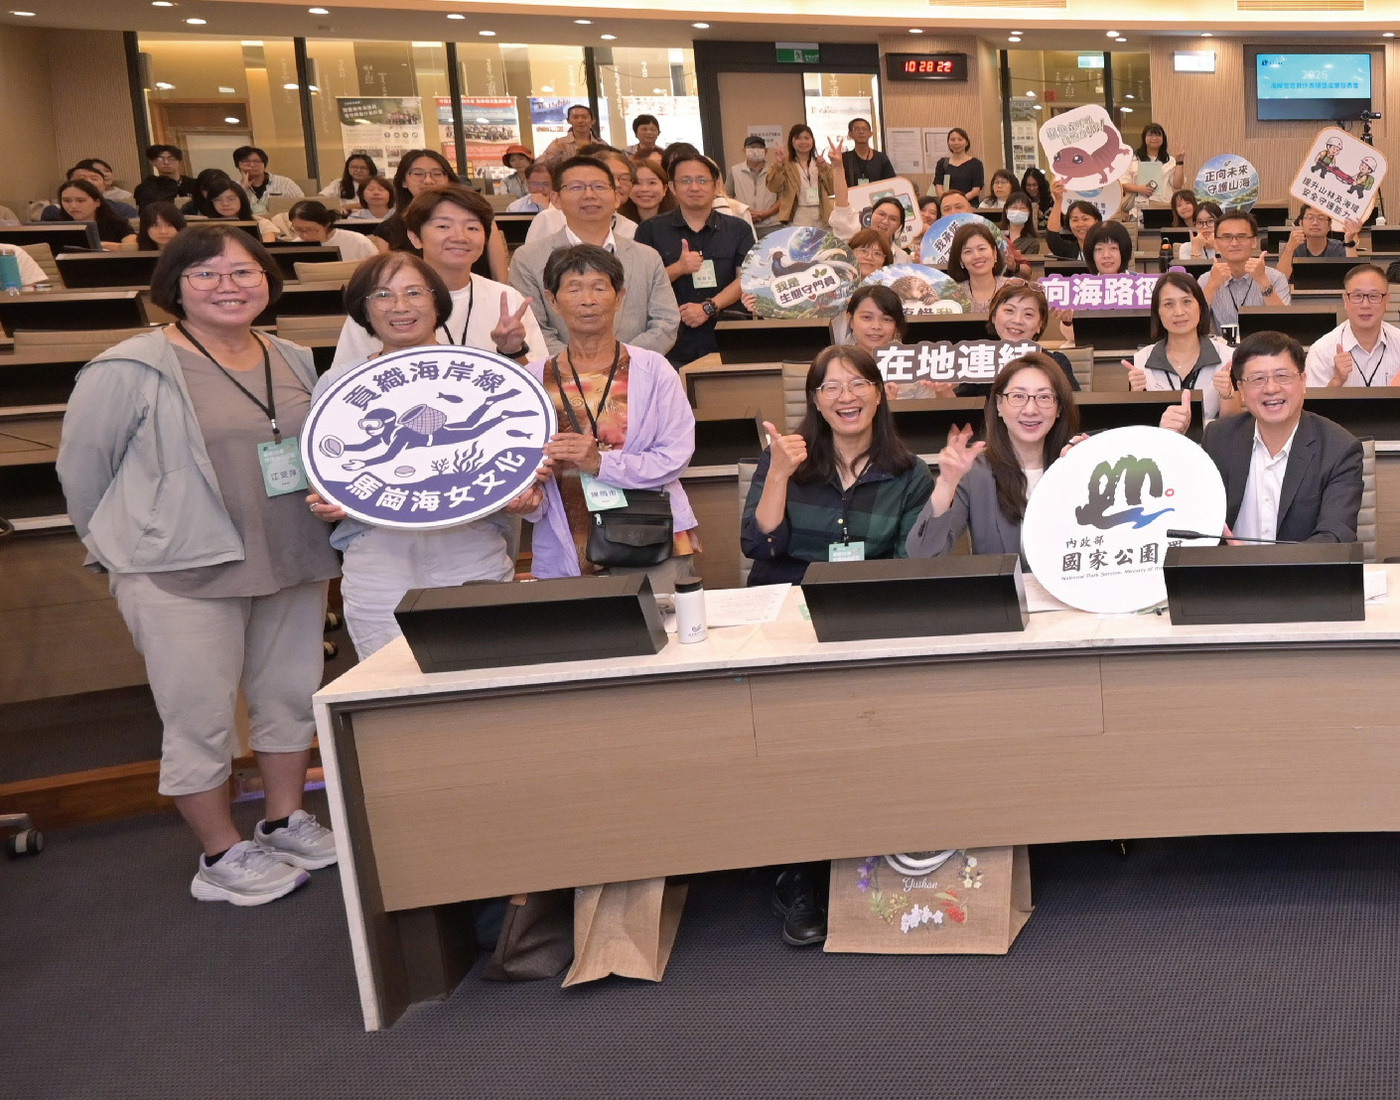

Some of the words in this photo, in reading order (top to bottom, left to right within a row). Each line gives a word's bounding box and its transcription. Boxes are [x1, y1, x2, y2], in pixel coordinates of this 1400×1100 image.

[905, 60, 916, 72] 10
[919, 60, 933, 72] 28
[1302, 70, 1329, 80] 2026
[1205, 164, 1249, 183] 正向未來
[1207, 177, 1251, 196] 守護山海
[1301, 187, 1351, 220] 安全守護能力
[1302, 176, 1360, 214] 提升山林及海域
[343, 360, 506, 411] 貢織海岸線
[345, 451, 526, 512] 馬崗海女文化
